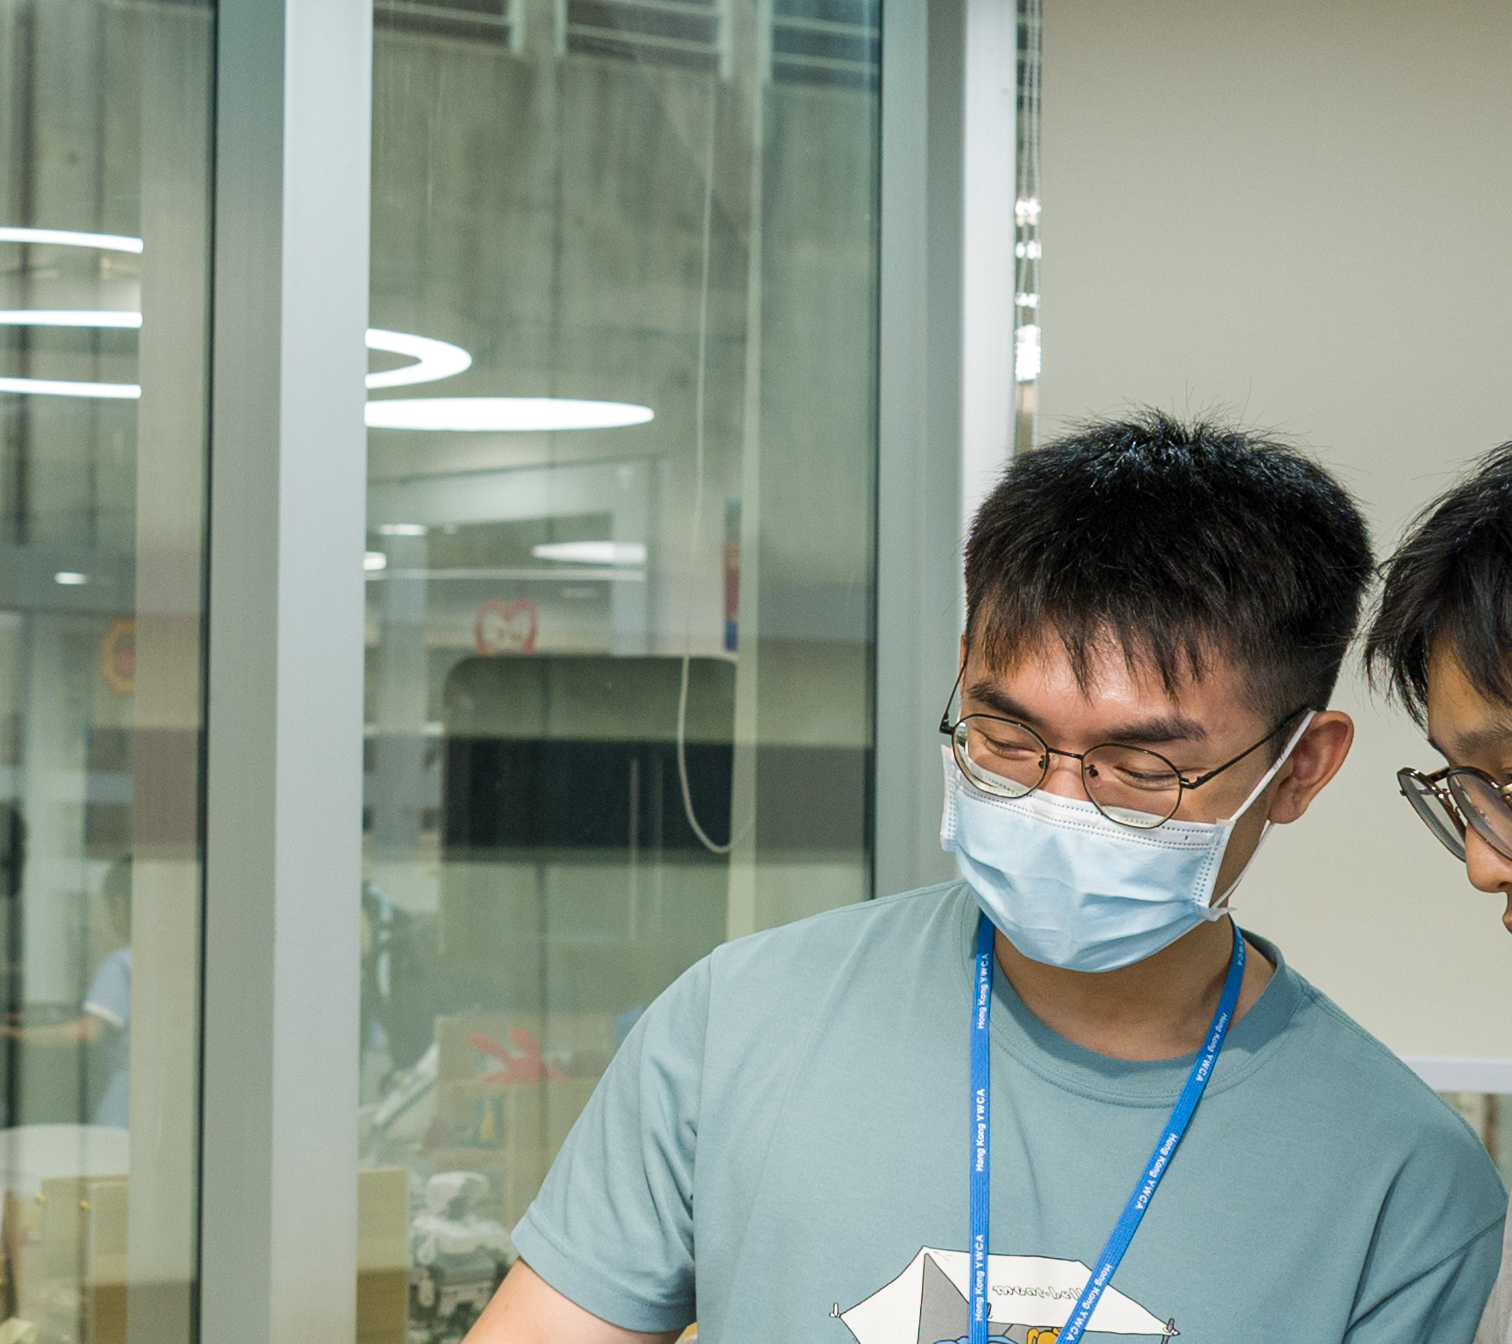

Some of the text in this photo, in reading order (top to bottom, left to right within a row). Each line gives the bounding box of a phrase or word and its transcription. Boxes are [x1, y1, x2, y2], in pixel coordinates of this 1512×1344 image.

[977, 953, 989, 1029] Hong Kong YWCA
[1195, 1012, 1227, 1082] Hong Kong YWCA
[976, 1088, 986, 1172] Hong Kong YWCA
[1136, 1133, 1178, 1209] Hong Kong YWCA
[975, 1234, 985, 1321] Hong Kong YWCA
[1066, 1263, 1113, 1341] Hong Kong YWCA
